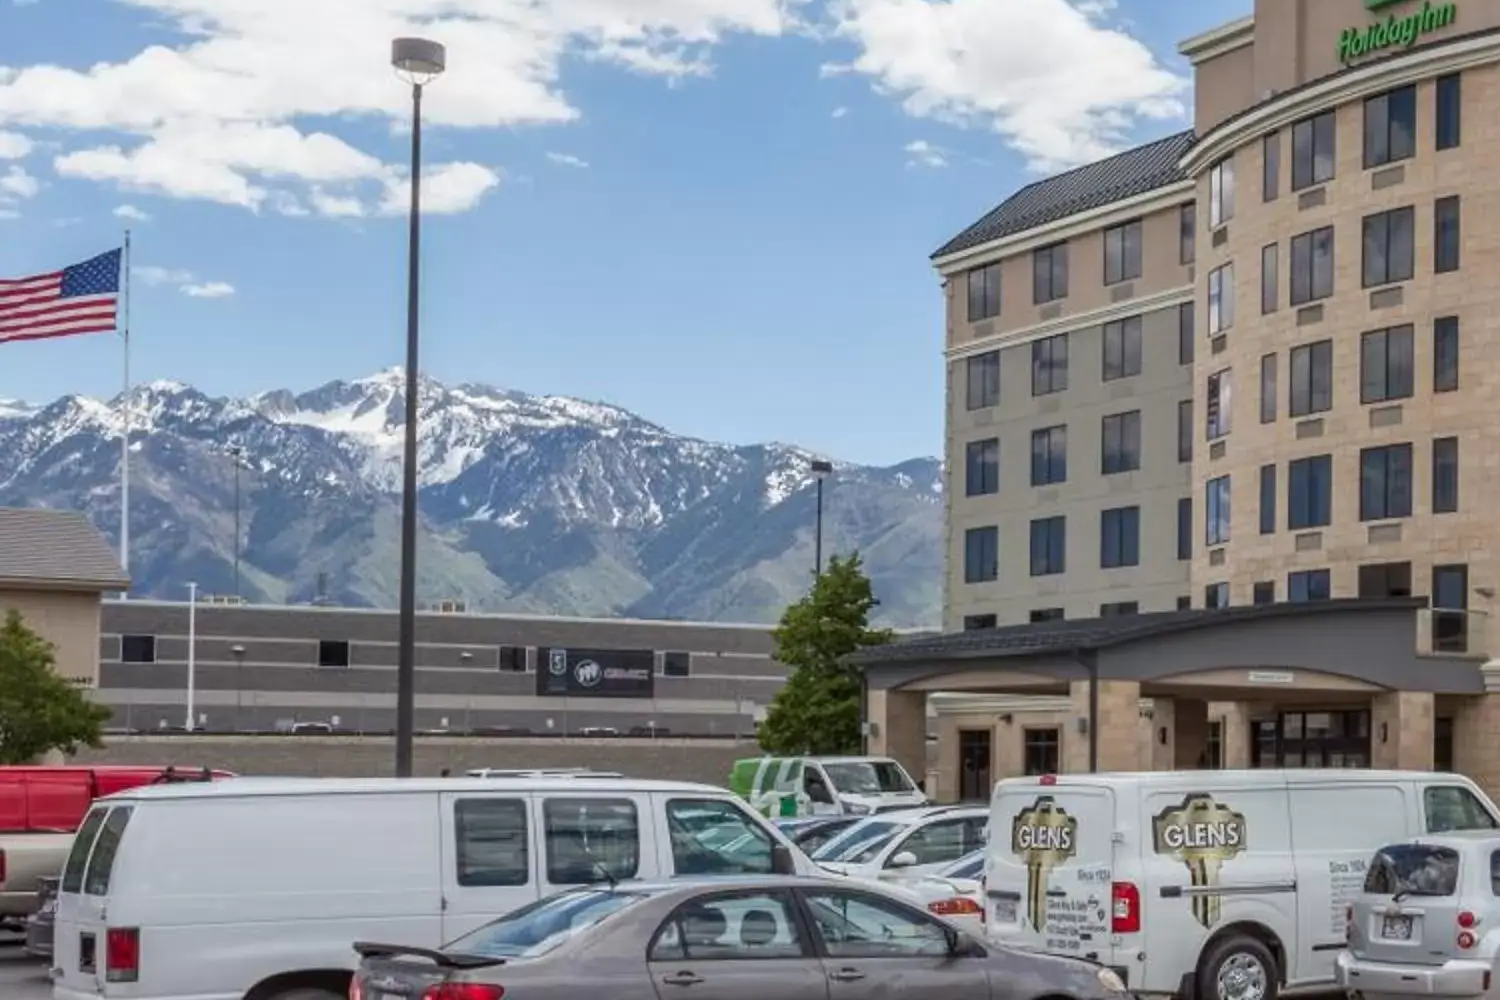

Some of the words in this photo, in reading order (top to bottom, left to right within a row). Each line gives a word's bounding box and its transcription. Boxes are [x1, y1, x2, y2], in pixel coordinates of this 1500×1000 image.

[1337, 14, 1419, 62] Holiday
[1419, 0, 1456, 32] Inn
[1019, 823, 1071, 850] GLENS
[1163, 822, 1240, 848] GLENS
